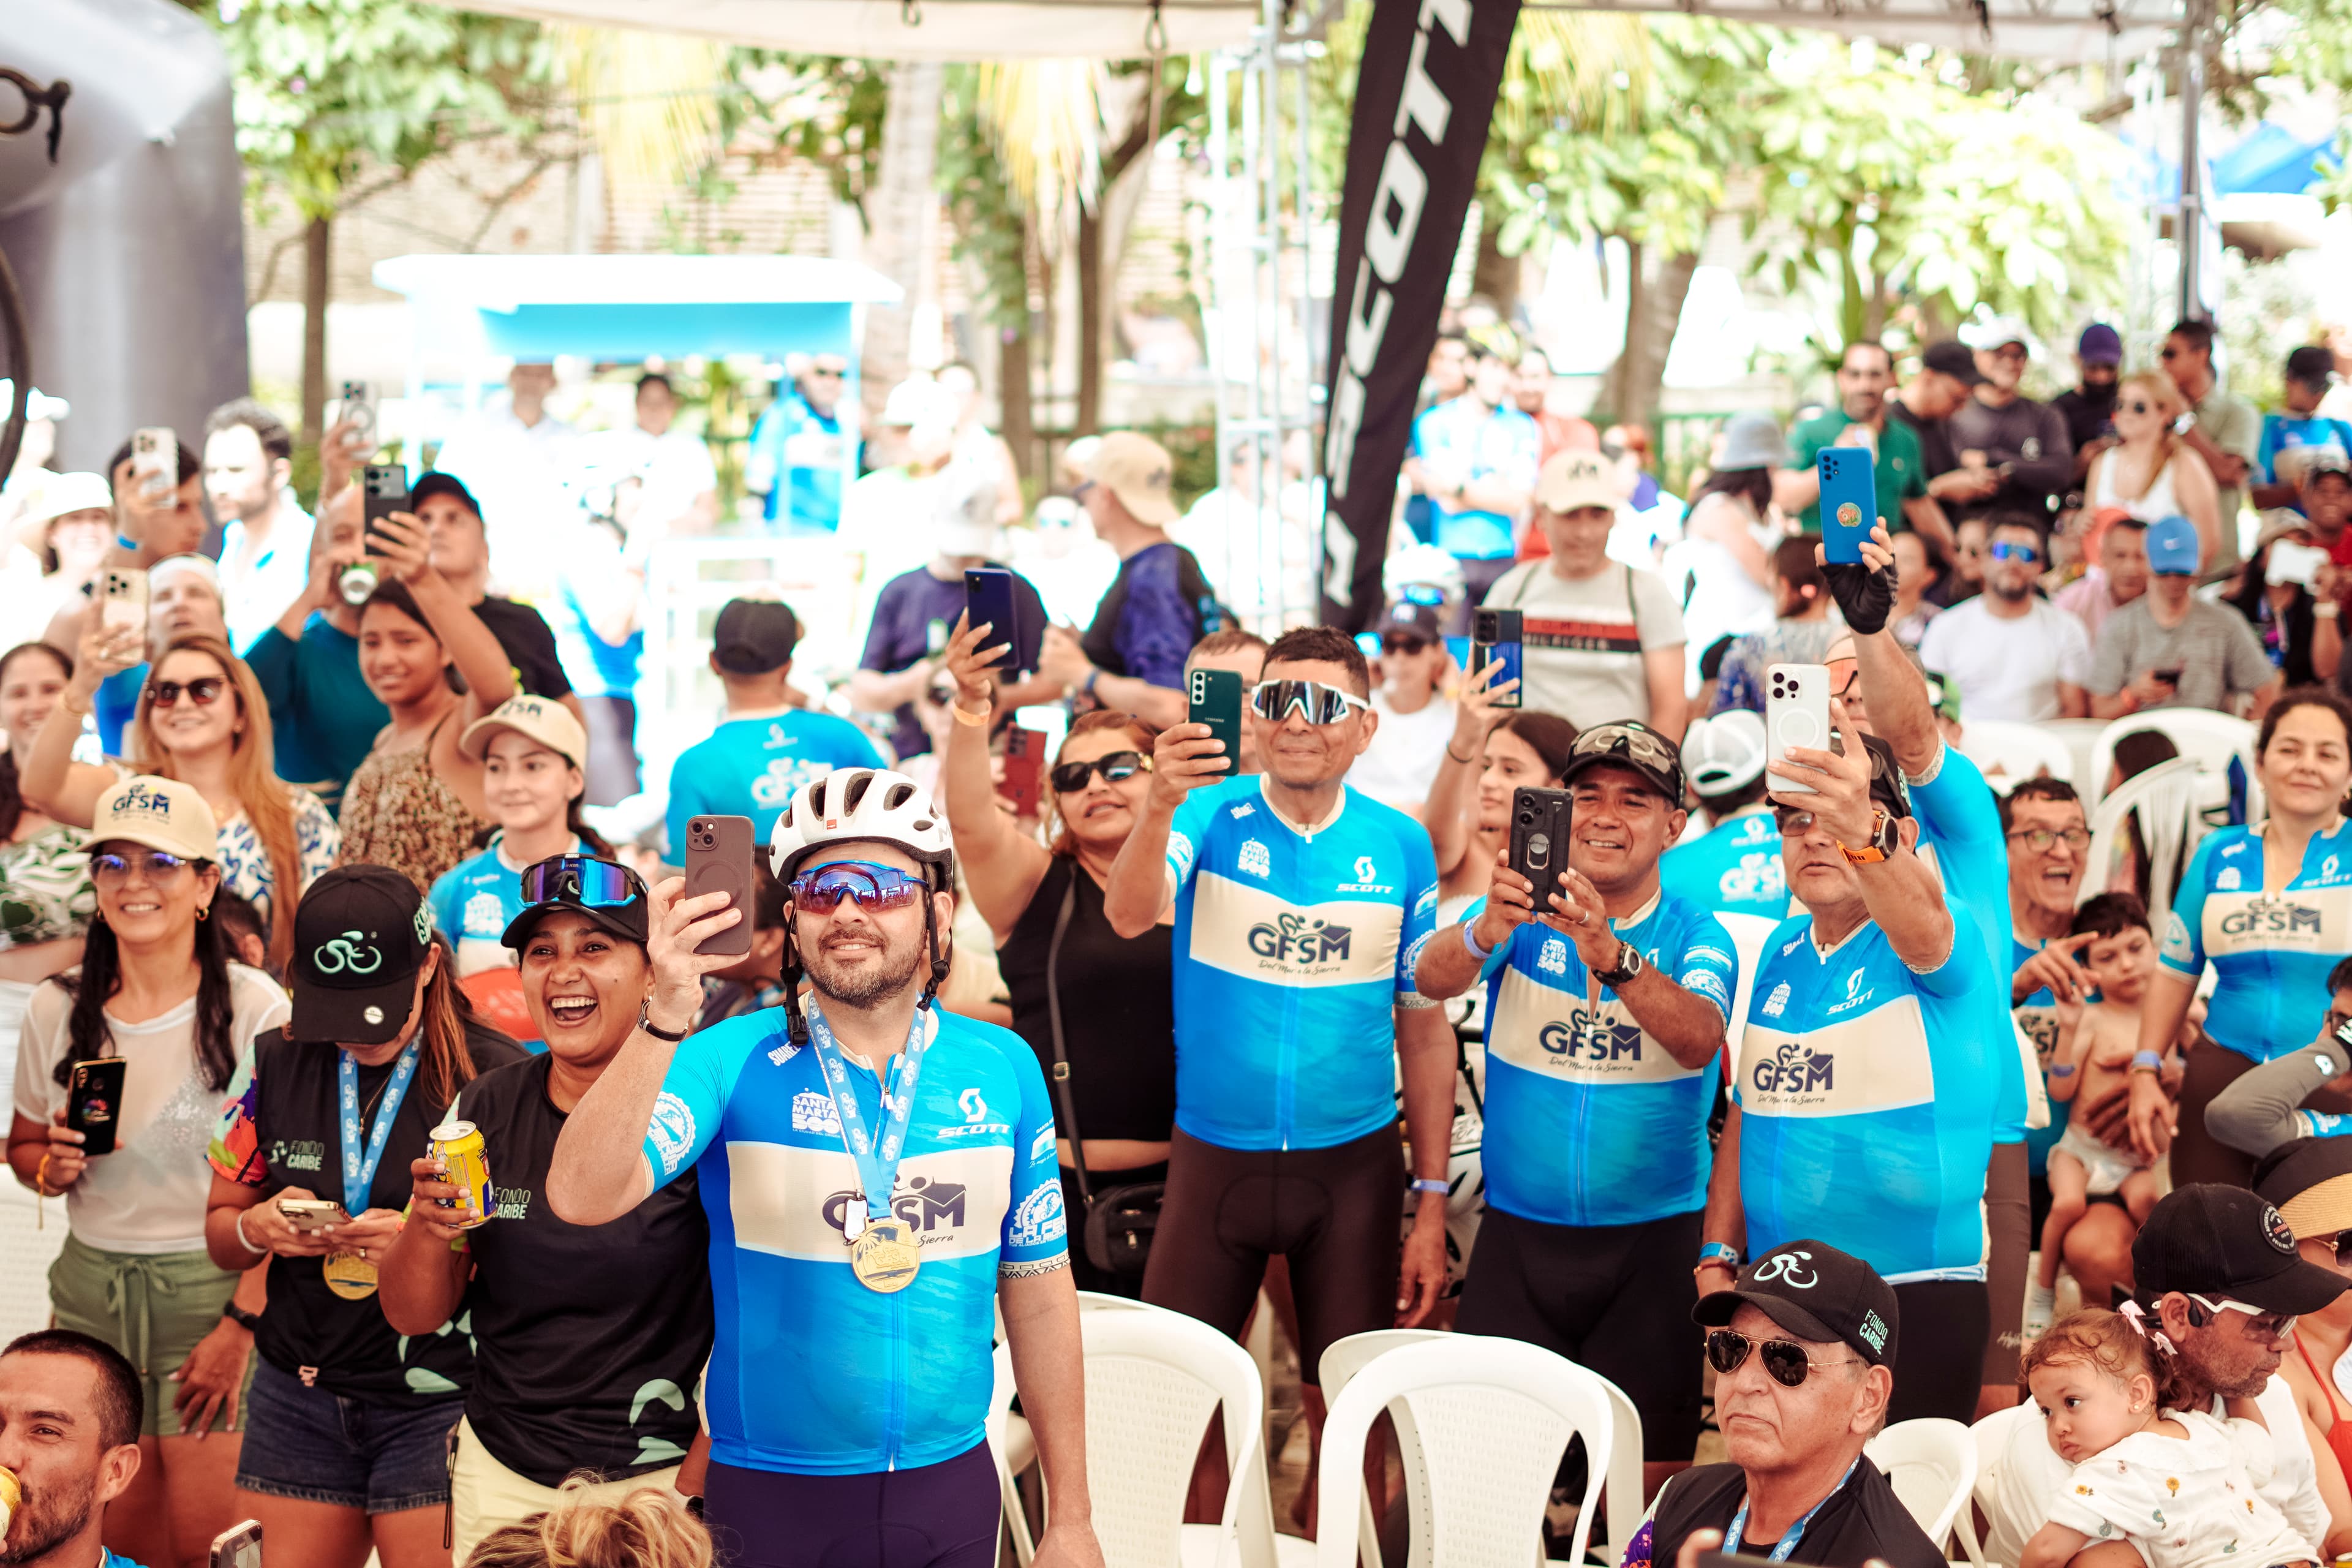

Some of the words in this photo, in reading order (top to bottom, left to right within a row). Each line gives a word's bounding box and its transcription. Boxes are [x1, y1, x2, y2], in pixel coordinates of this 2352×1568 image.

[113, 794, 169, 813] GFSM
[1242, 842, 1269, 856] SANTA
[1240, 850, 1270, 866] MARTA
[1719, 865, 1785, 894] GFS
[1335, 883, 1393, 894] SCOTT
[2222, 910, 2321, 934] GFSM
[1248, 926, 1351, 964] GFSM
[1258, 960, 1275, 970] Del
[1278, 963, 1294, 974] Mar
[1312, 965, 1341, 975] Sierra
[1769, 993, 1788, 1005] MARTA
[1773, 987, 1790, 997] SANTA
[1826, 987, 1875, 1015] SCOTT
[816, 1023, 831, 1049] GFSM
[1539, 1024, 1641, 1060] GFSM
[829, 1058, 844, 1083] GFSM
[1548, 1057, 1567, 1066] Del
[1568, 1060, 1585, 1071] Mar
[1603, 1063, 1634, 1072] Sierra
[902, 1060, 916, 1087] GFSM
[1754, 1059, 1833, 1093] GFSM
[793, 1095, 834, 1110] SANTA
[840, 1091, 856, 1118] GFSM
[1798, 1095, 1825, 1105] Sierra
[793, 1104, 839, 1120] MARTA
[937, 1123, 1011, 1139] SCOTT
[287, 1154, 323, 1171] CARIBE
[495, 1187, 532, 1204] FONDO
[492, 1204, 528, 1219] ARIBE
[1009, 1224, 1038, 1238] LA
[918, 1234, 954, 1248] Sierra
[1864, 1309, 1888, 1340] FONDO
[1859, 1323, 1885, 1355] CARIBE
